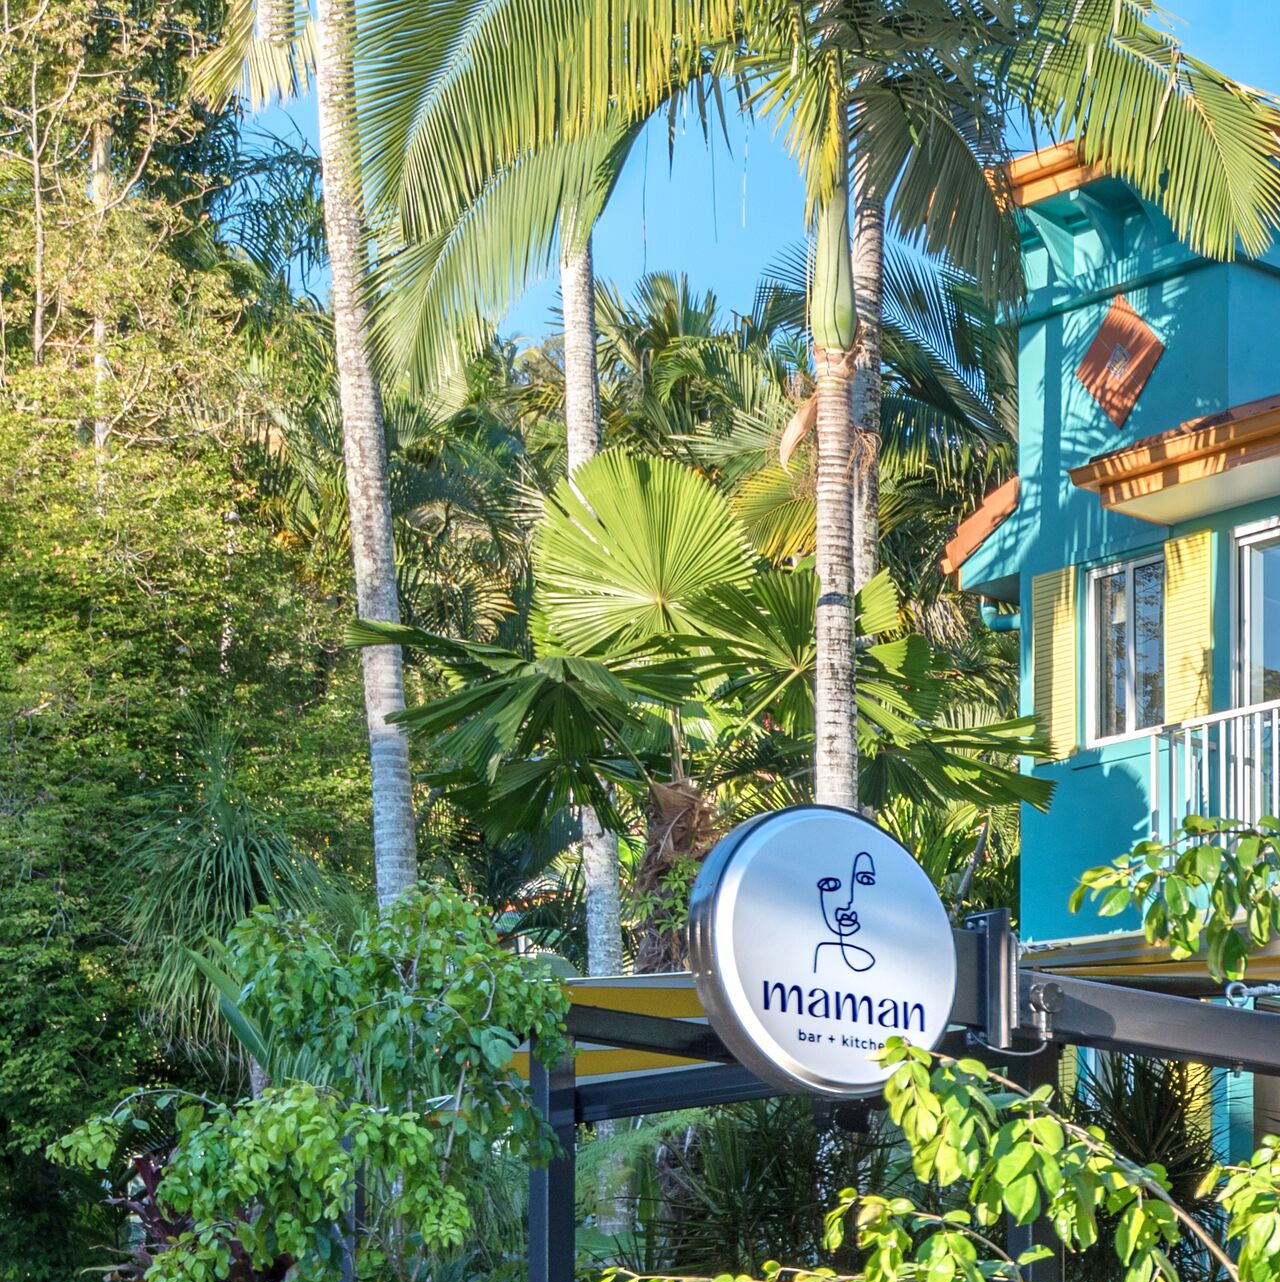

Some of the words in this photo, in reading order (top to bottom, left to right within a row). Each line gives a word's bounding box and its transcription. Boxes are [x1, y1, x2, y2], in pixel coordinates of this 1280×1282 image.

[762, 979, 926, 1032] maman
[798, 1028, 822, 1043] bar
[841, 1033, 887, 1051] kitche
